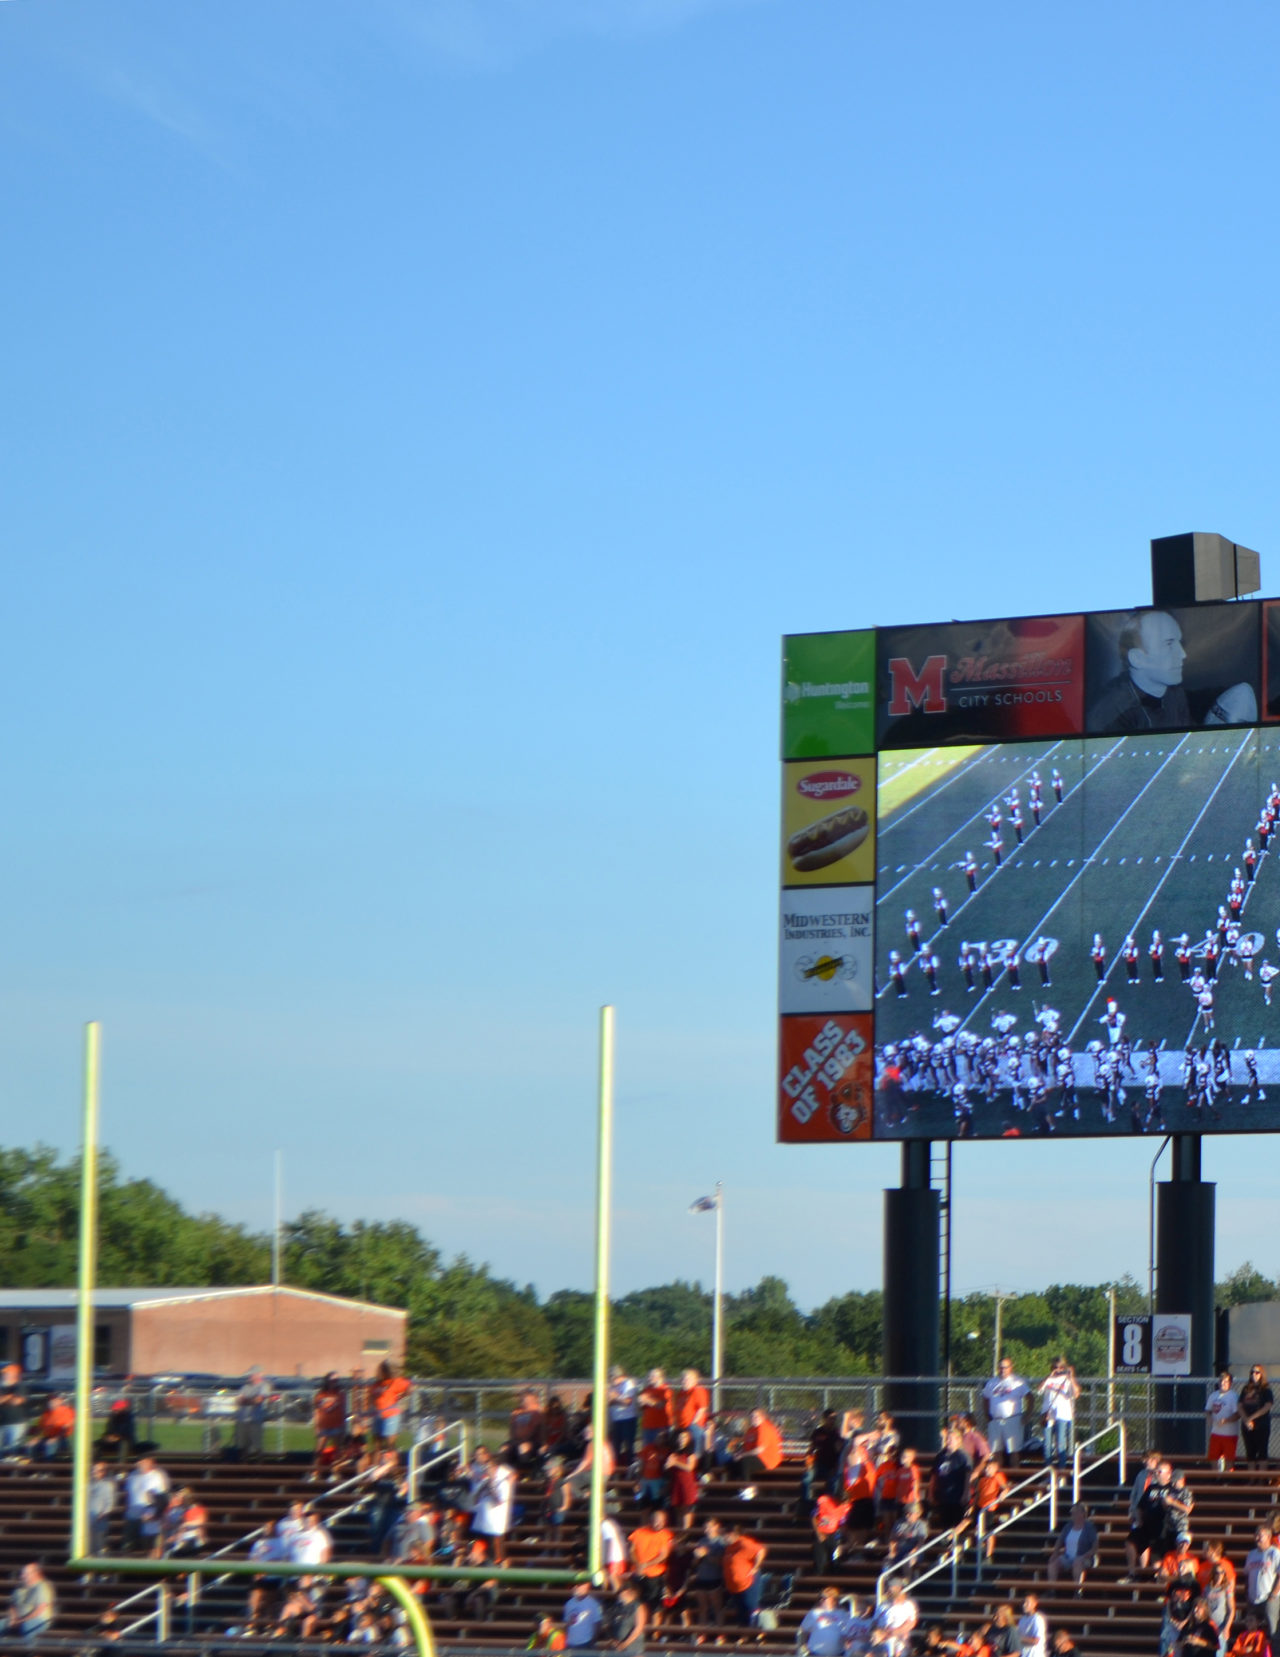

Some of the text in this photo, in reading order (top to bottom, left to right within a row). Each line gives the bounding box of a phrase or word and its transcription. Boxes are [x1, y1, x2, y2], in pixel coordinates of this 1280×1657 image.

[801, 681, 869, 699] Huntington
[958, 689, 1063, 708] CITY SCHOOLS
[800, 776, 858, 797] Sugardale
[783, 912, 869, 929] MIDWESTERN
[781, 1019, 845, 1098] CLASS
[790, 1028, 867, 1125] OF 1983
[1122, 1323, 1143, 1366] 8
